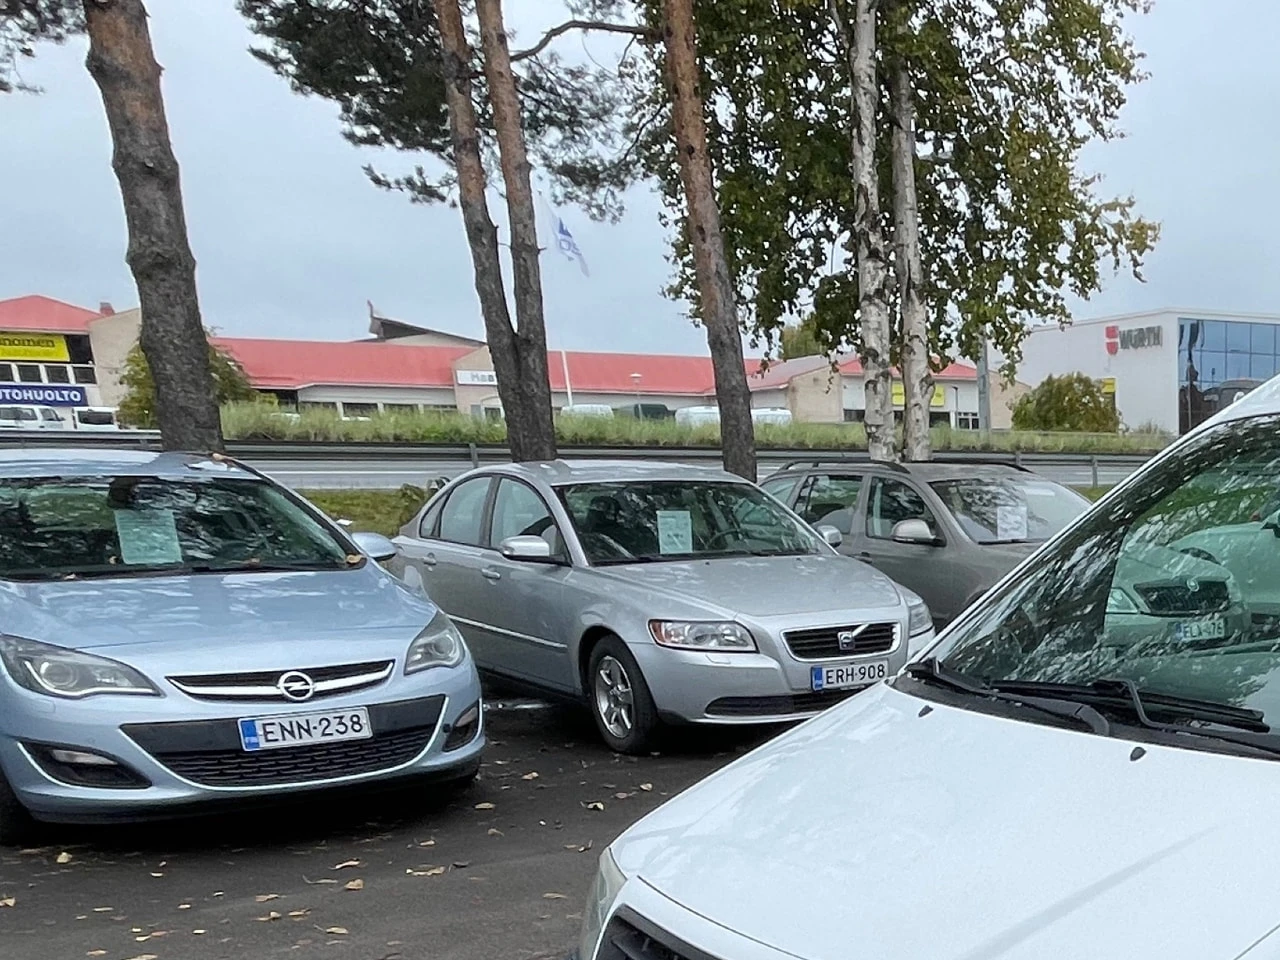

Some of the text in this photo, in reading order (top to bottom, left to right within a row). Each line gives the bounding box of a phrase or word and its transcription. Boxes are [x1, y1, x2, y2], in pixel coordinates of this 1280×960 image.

[0, 388, 81, 402] TOHUOLTO
[826, 664, 885, 685] ERH-908
[262, 714, 363, 742] ENN-238
